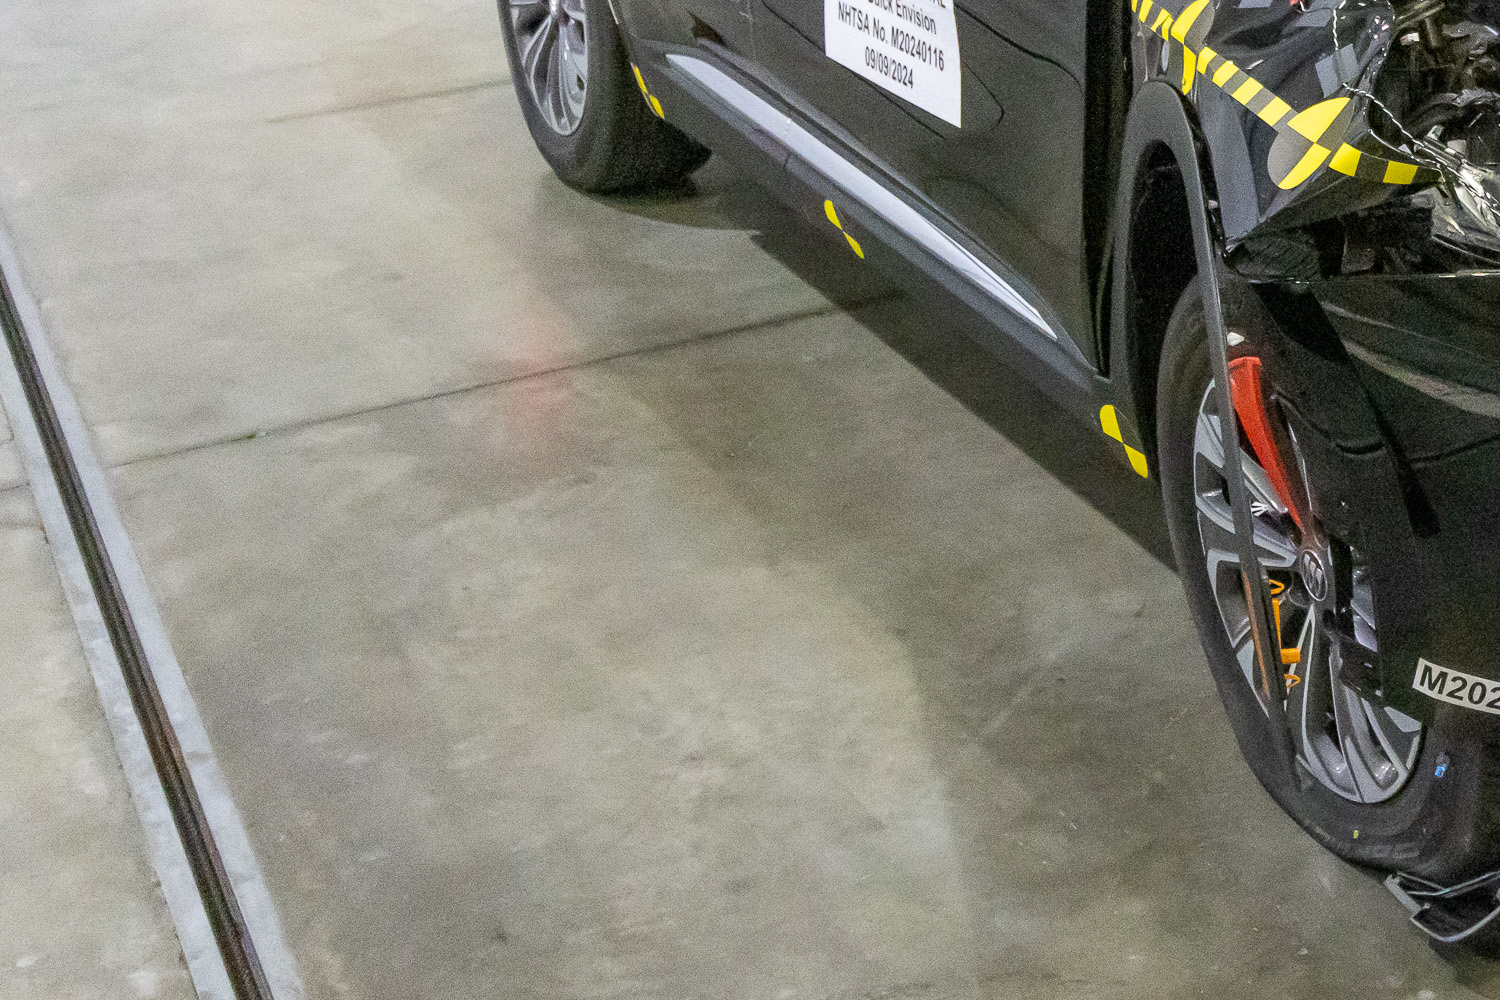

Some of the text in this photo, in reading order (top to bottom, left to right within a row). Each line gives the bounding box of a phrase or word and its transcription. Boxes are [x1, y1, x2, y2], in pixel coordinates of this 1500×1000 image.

[838, 1, 944, 71] NHTSA No. M20240116
[864, 46, 914, 88] 09/09/2024
